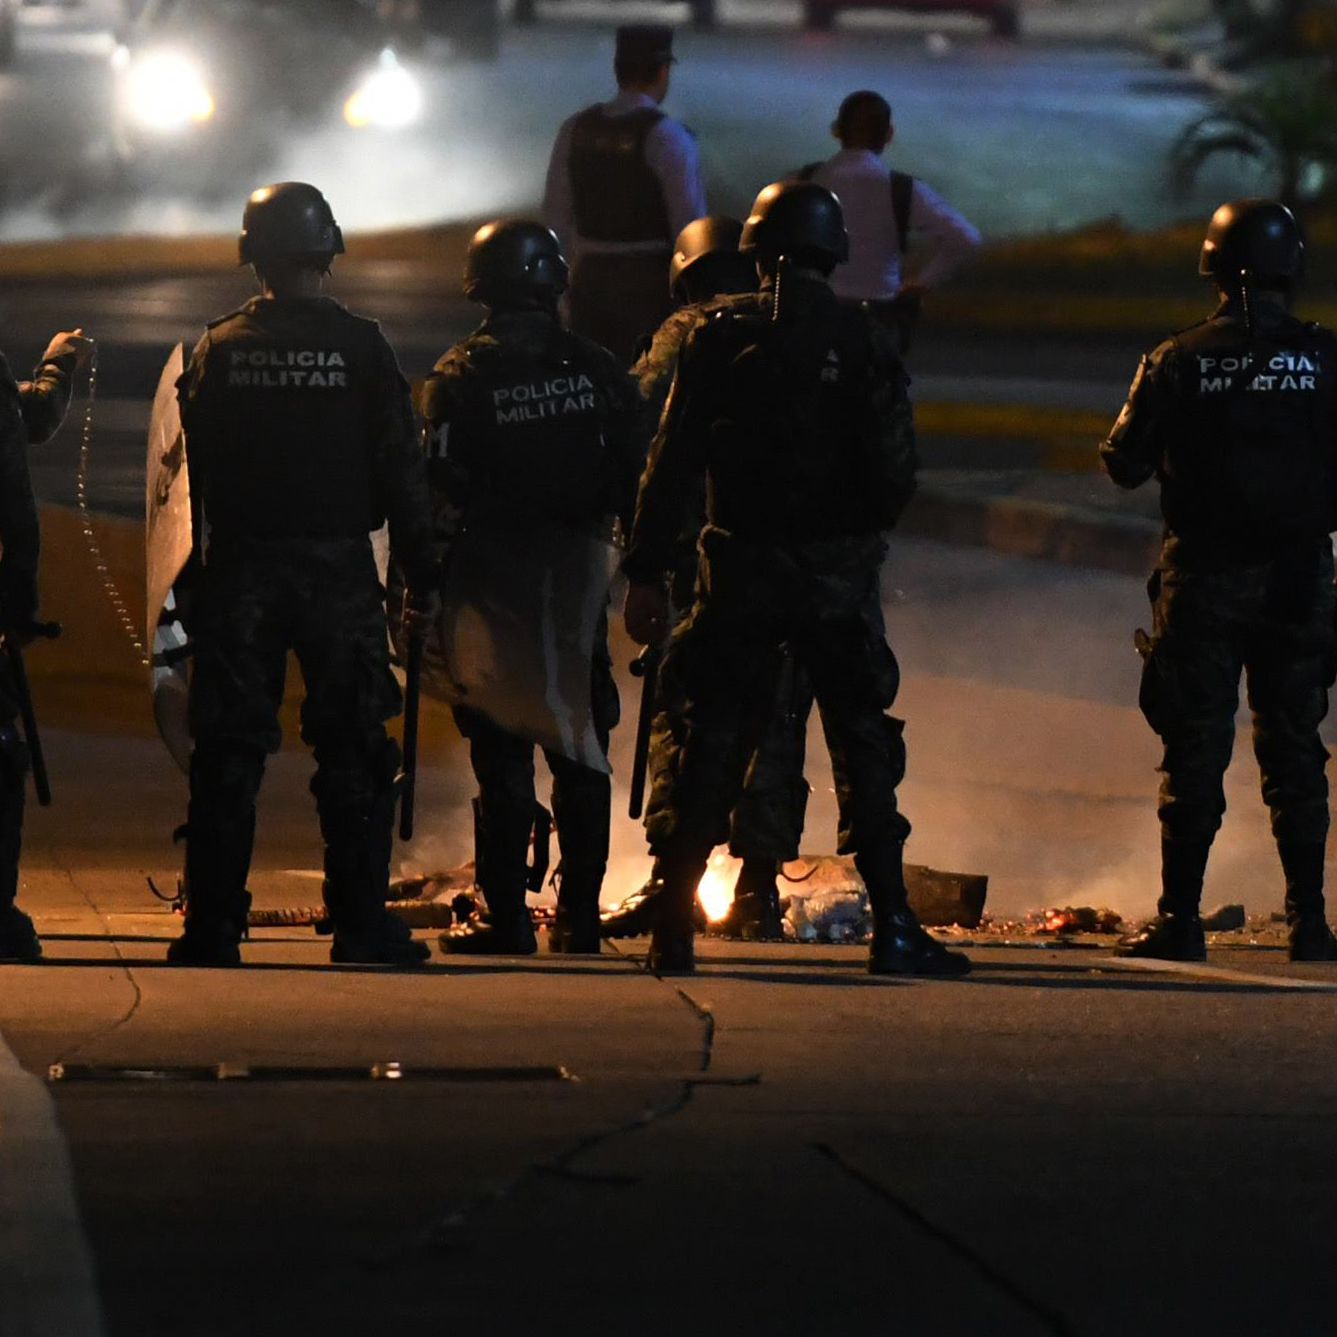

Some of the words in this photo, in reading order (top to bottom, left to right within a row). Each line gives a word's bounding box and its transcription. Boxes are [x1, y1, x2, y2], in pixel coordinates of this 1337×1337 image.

[231, 350, 346, 367] POLICIA
[229, 370, 348, 387] MILITAR
[493, 374, 594, 406] POLICIA
[495, 392, 595, 426] MILITAR
